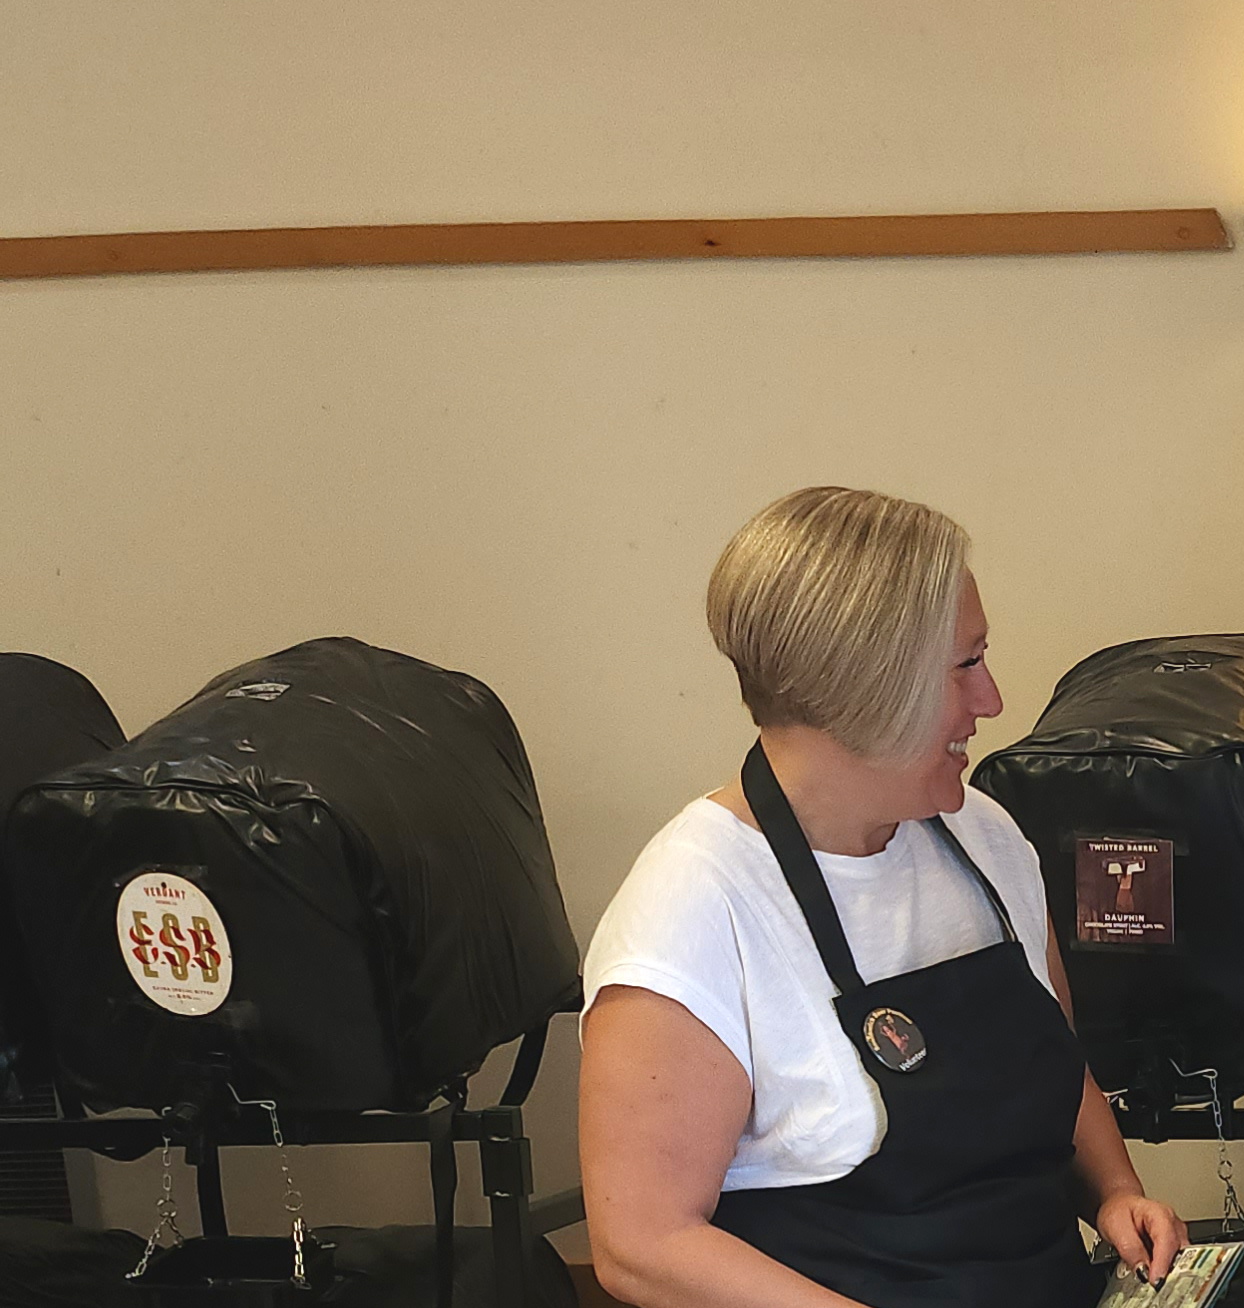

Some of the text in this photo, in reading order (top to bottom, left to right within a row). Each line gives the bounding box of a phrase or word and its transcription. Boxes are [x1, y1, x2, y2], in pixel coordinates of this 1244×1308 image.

[1088, 843, 1158, 853] TWISTED BARREL
[1104, 913, 1145, 922] DAUPHIN
